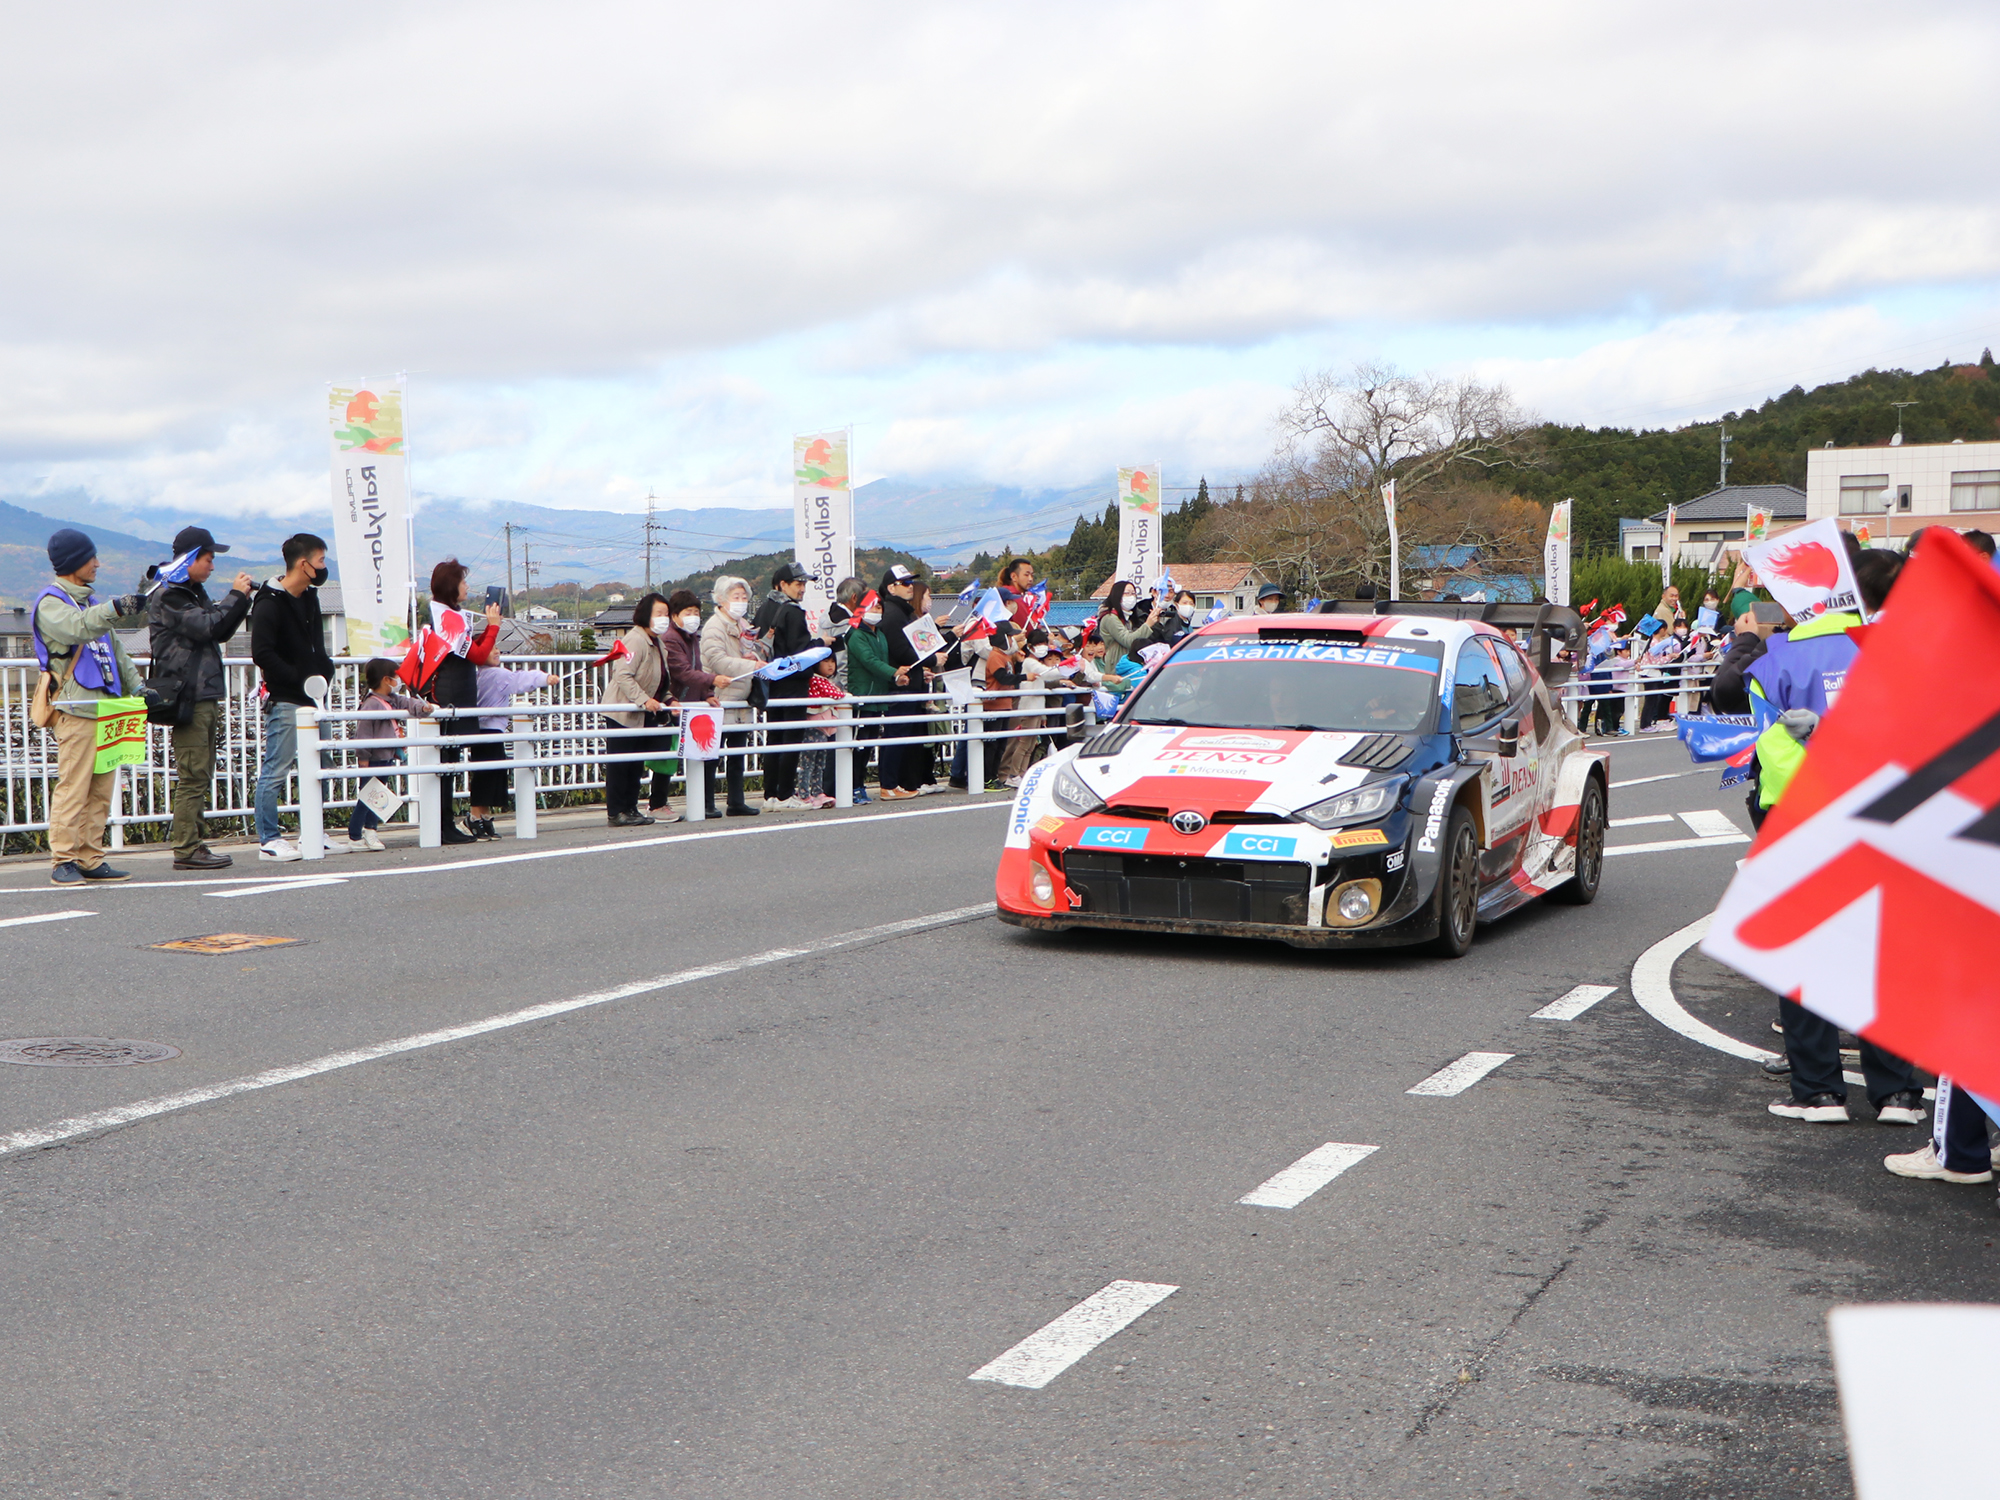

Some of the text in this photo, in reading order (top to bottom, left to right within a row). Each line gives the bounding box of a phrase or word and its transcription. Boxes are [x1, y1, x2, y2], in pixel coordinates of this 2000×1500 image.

[1362, 641, 1417, 654] Racing
[1153, 750, 1288, 765] DENSO
[1189, 765, 1248, 776] Microsoft
[1511, 761, 1538, 796] DENSO
[1014, 762, 1056, 835] Panasonic
[1333, 832, 1384, 846] PIRELLI
[1386, 852, 1405, 869] OMP
